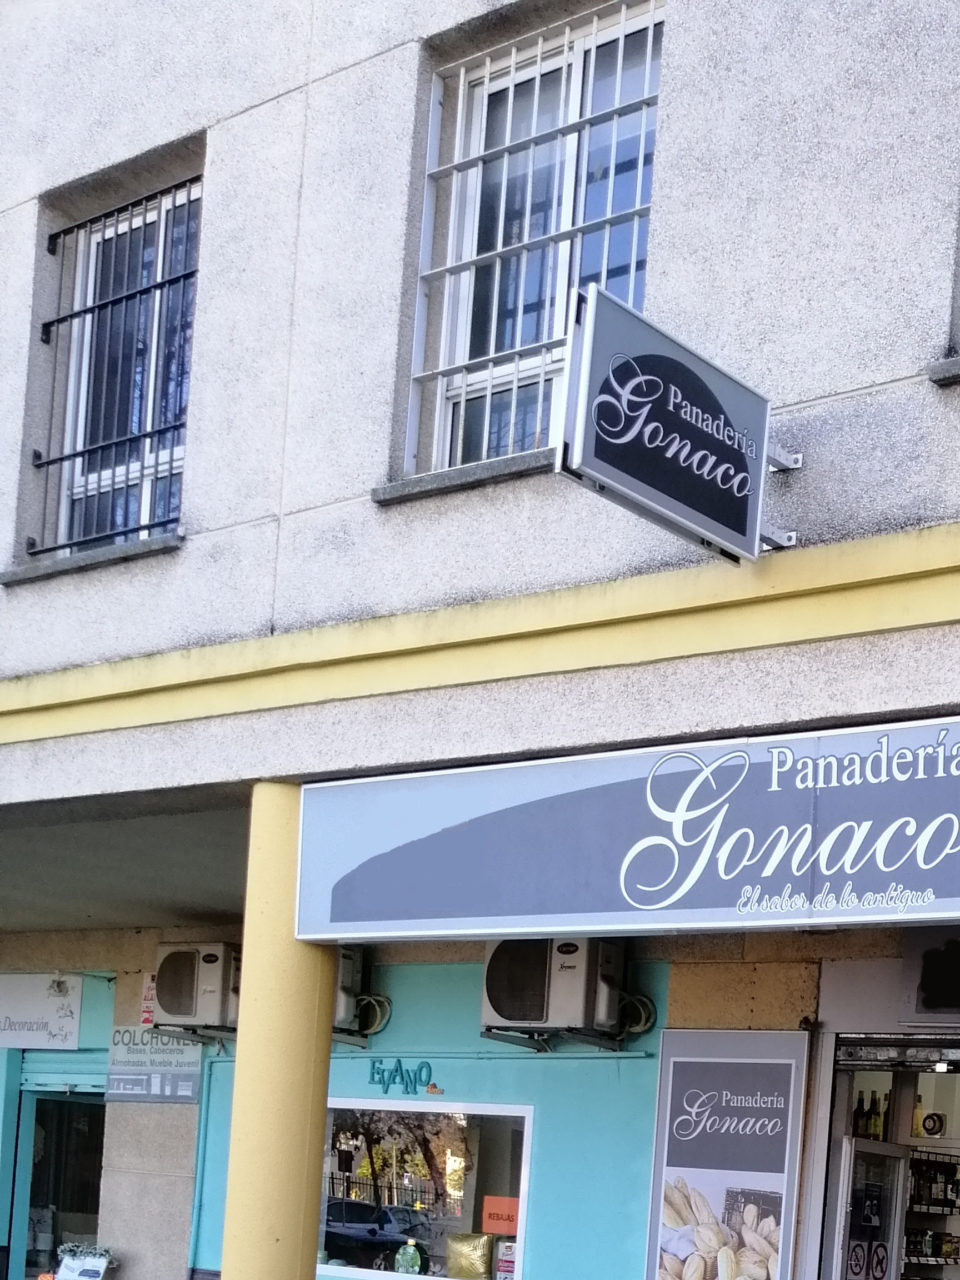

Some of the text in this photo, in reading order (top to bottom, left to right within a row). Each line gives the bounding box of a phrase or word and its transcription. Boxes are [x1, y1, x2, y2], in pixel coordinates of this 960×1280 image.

[591, 352, 755, 497] Gonaco
[667, 383, 758, 460] Panadería
[737, 881, 936, 914] El sabor de lo antiguo
[3, 1017, 49, 1033] Decoración
[368, 1058, 432, 1095] EVANO
[673, 1089, 783, 1140] Gonaco
[721, 1090, 785, 1108] Panadería
[488, 1212, 515, 1222] REBAJAS
